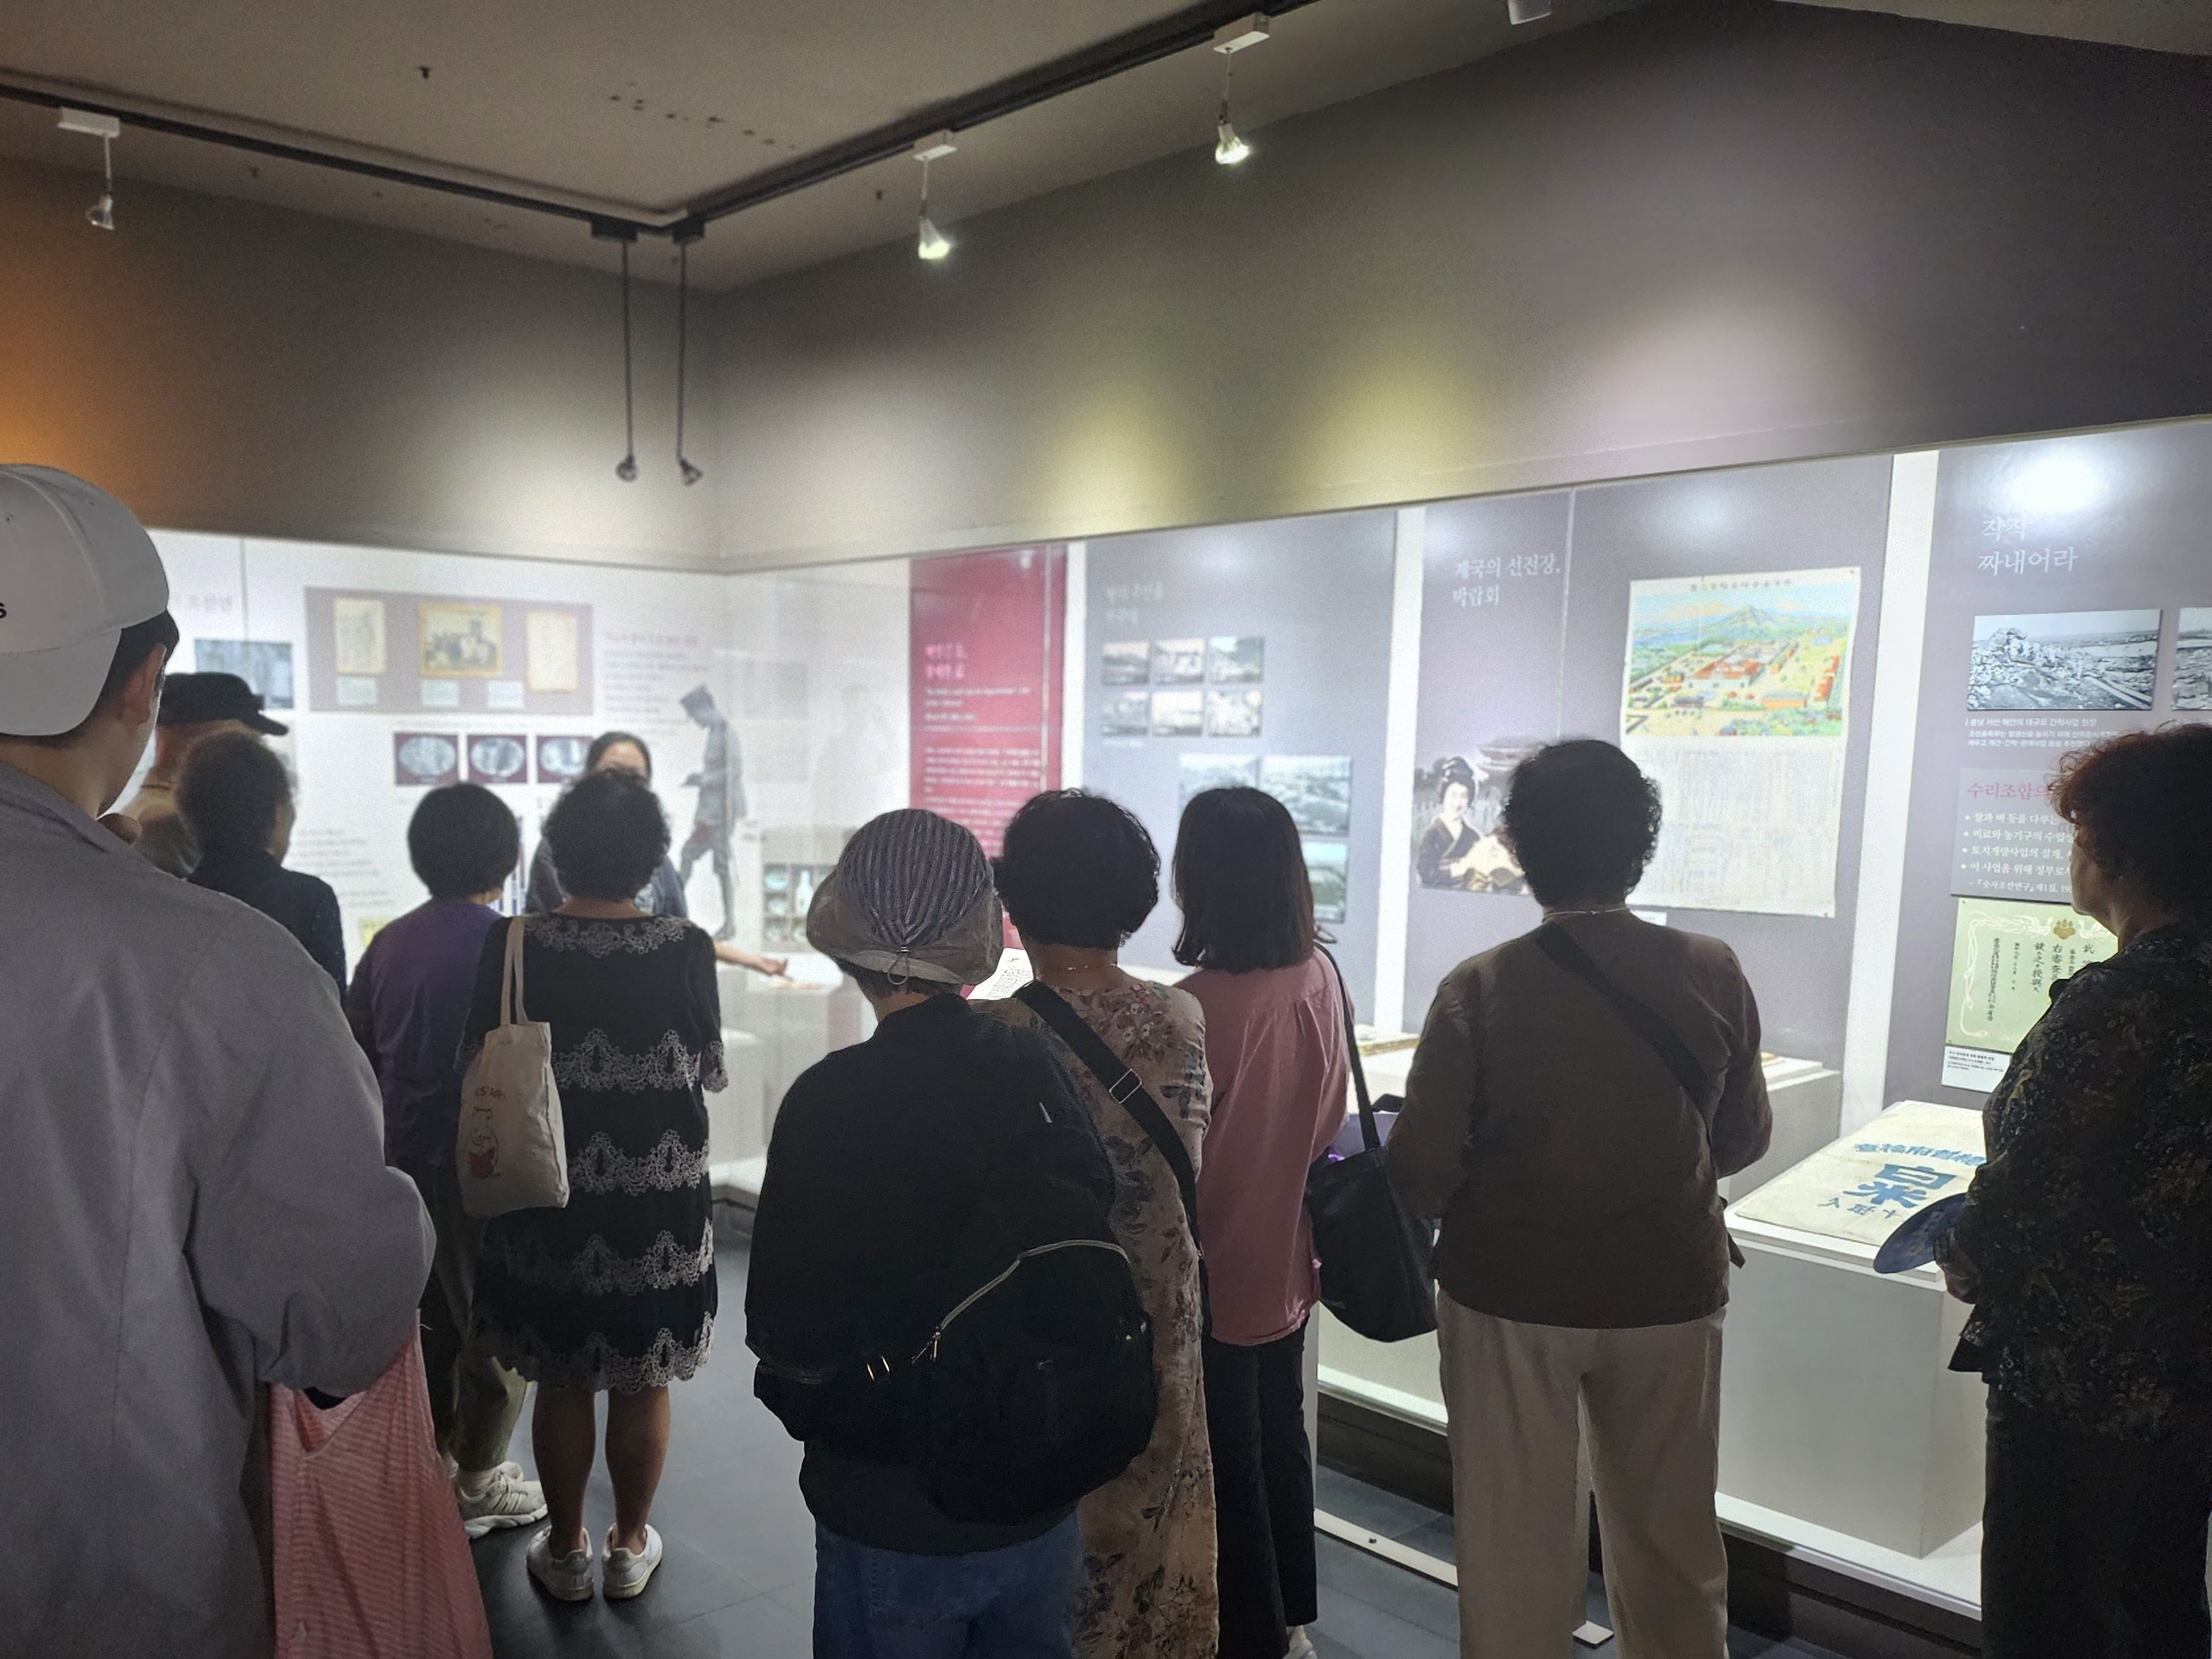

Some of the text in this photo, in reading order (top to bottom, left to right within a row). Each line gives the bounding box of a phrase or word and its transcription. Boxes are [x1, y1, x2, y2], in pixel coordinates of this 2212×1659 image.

[1977, 546, 2079, 576] 짜내어라
[2007, 813, 2028, 824] 등을
[2029, 814, 2059, 825] 다루는
[1973, 829, 2002, 840] 비료와
[2003, 830, 2043, 842] 농기구의
[1971, 845, 2039, 859] 토지개량사업의
[1970, 861, 1980, 872] 이
[1981, 862, 2011, 874] 사업을
[2013, 863, 2034, 875] 위해
